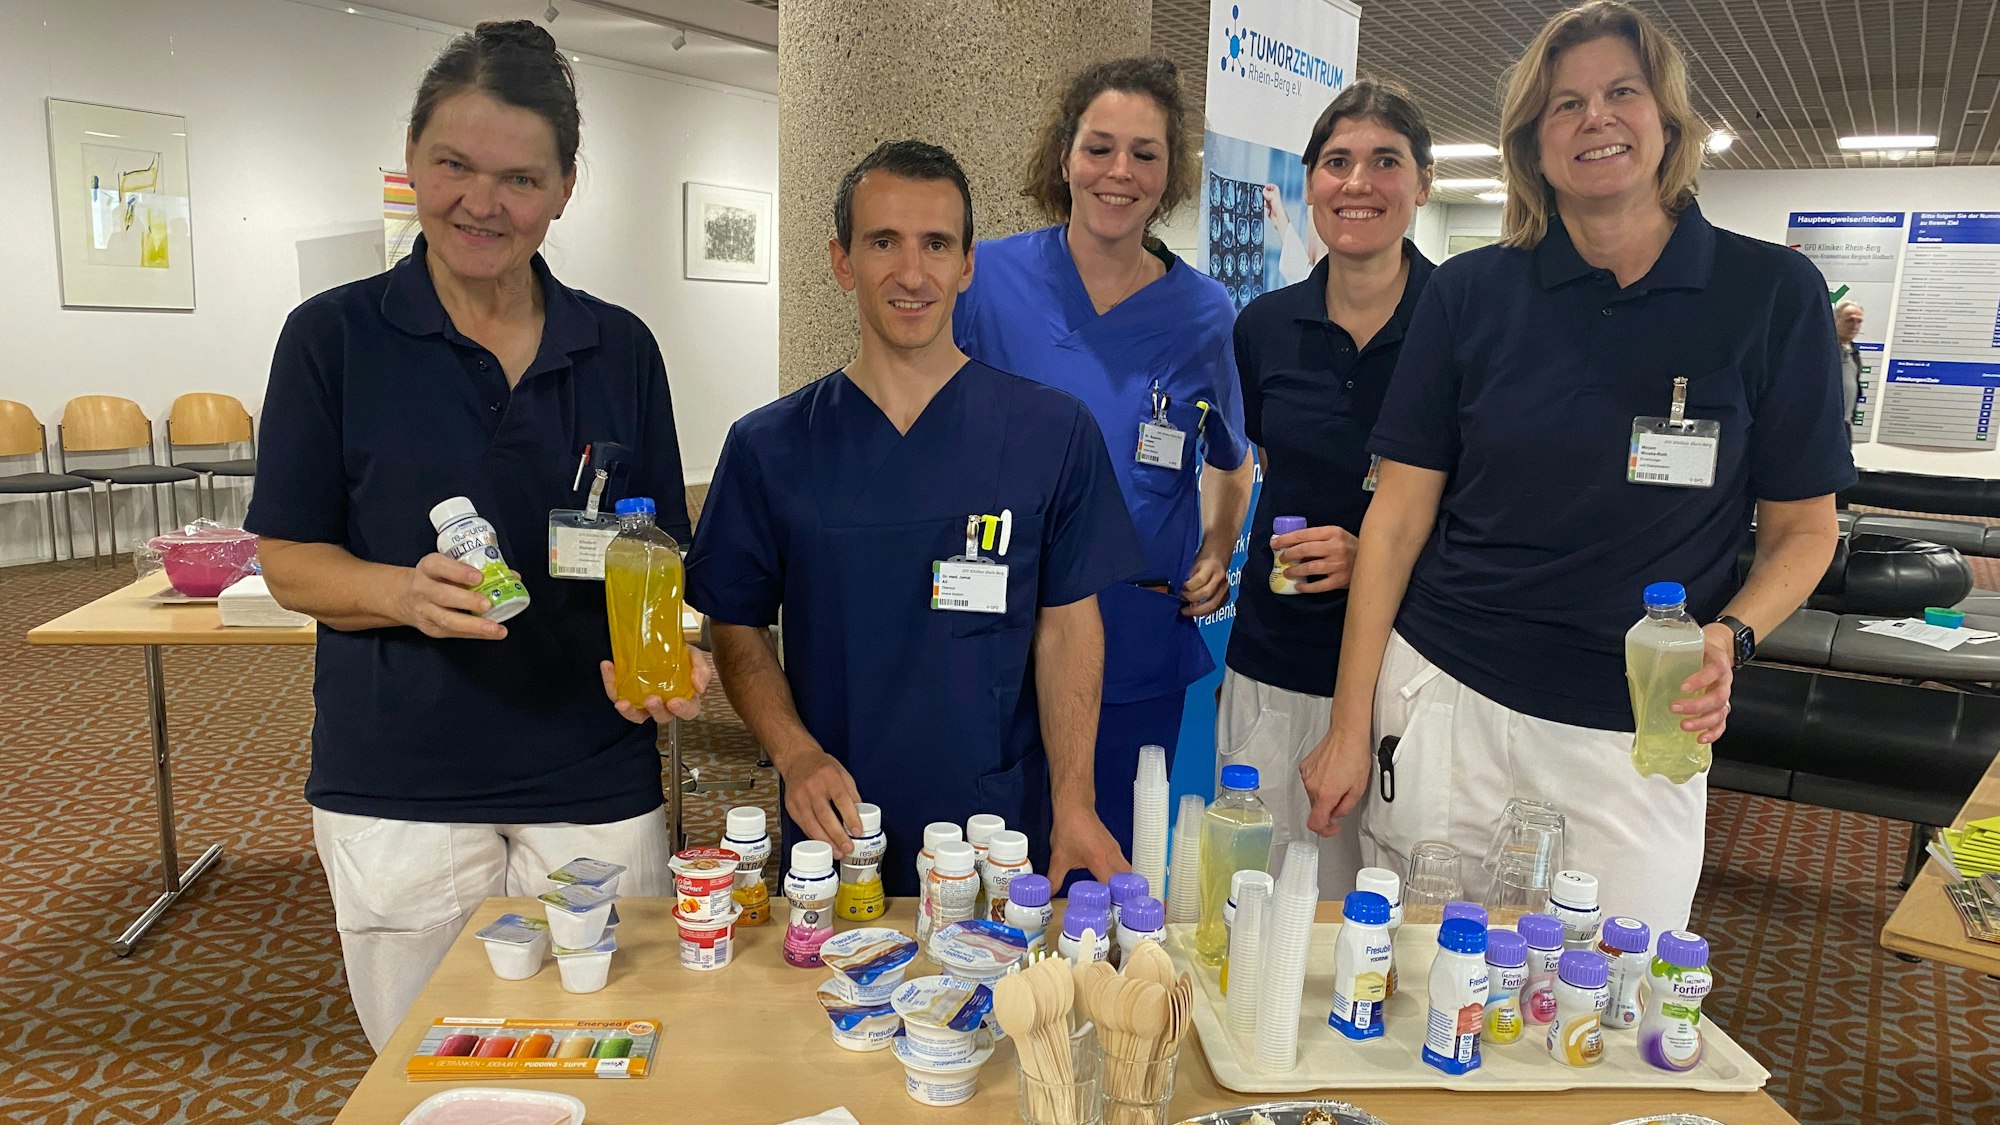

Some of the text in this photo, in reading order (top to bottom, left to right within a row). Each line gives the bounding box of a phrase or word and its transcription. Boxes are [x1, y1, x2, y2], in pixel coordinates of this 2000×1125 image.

[1249, 31, 1343, 91] TUMORZENTRUM
[1249, 63, 1302, 96] Rhein-Berg e.V.
[1797, 215, 1897, 224] Hauptwegweiser/Infotafel
[1817, 243, 1844, 251] Kliniken
[1845, 244, 1881, 253] Rhein-Berg
[451, 524, 489, 543] resource
[450, 538, 484, 559] ULTRA
[852, 856, 879, 866] ULTRA
[830, 930, 861, 946] Fresubin
